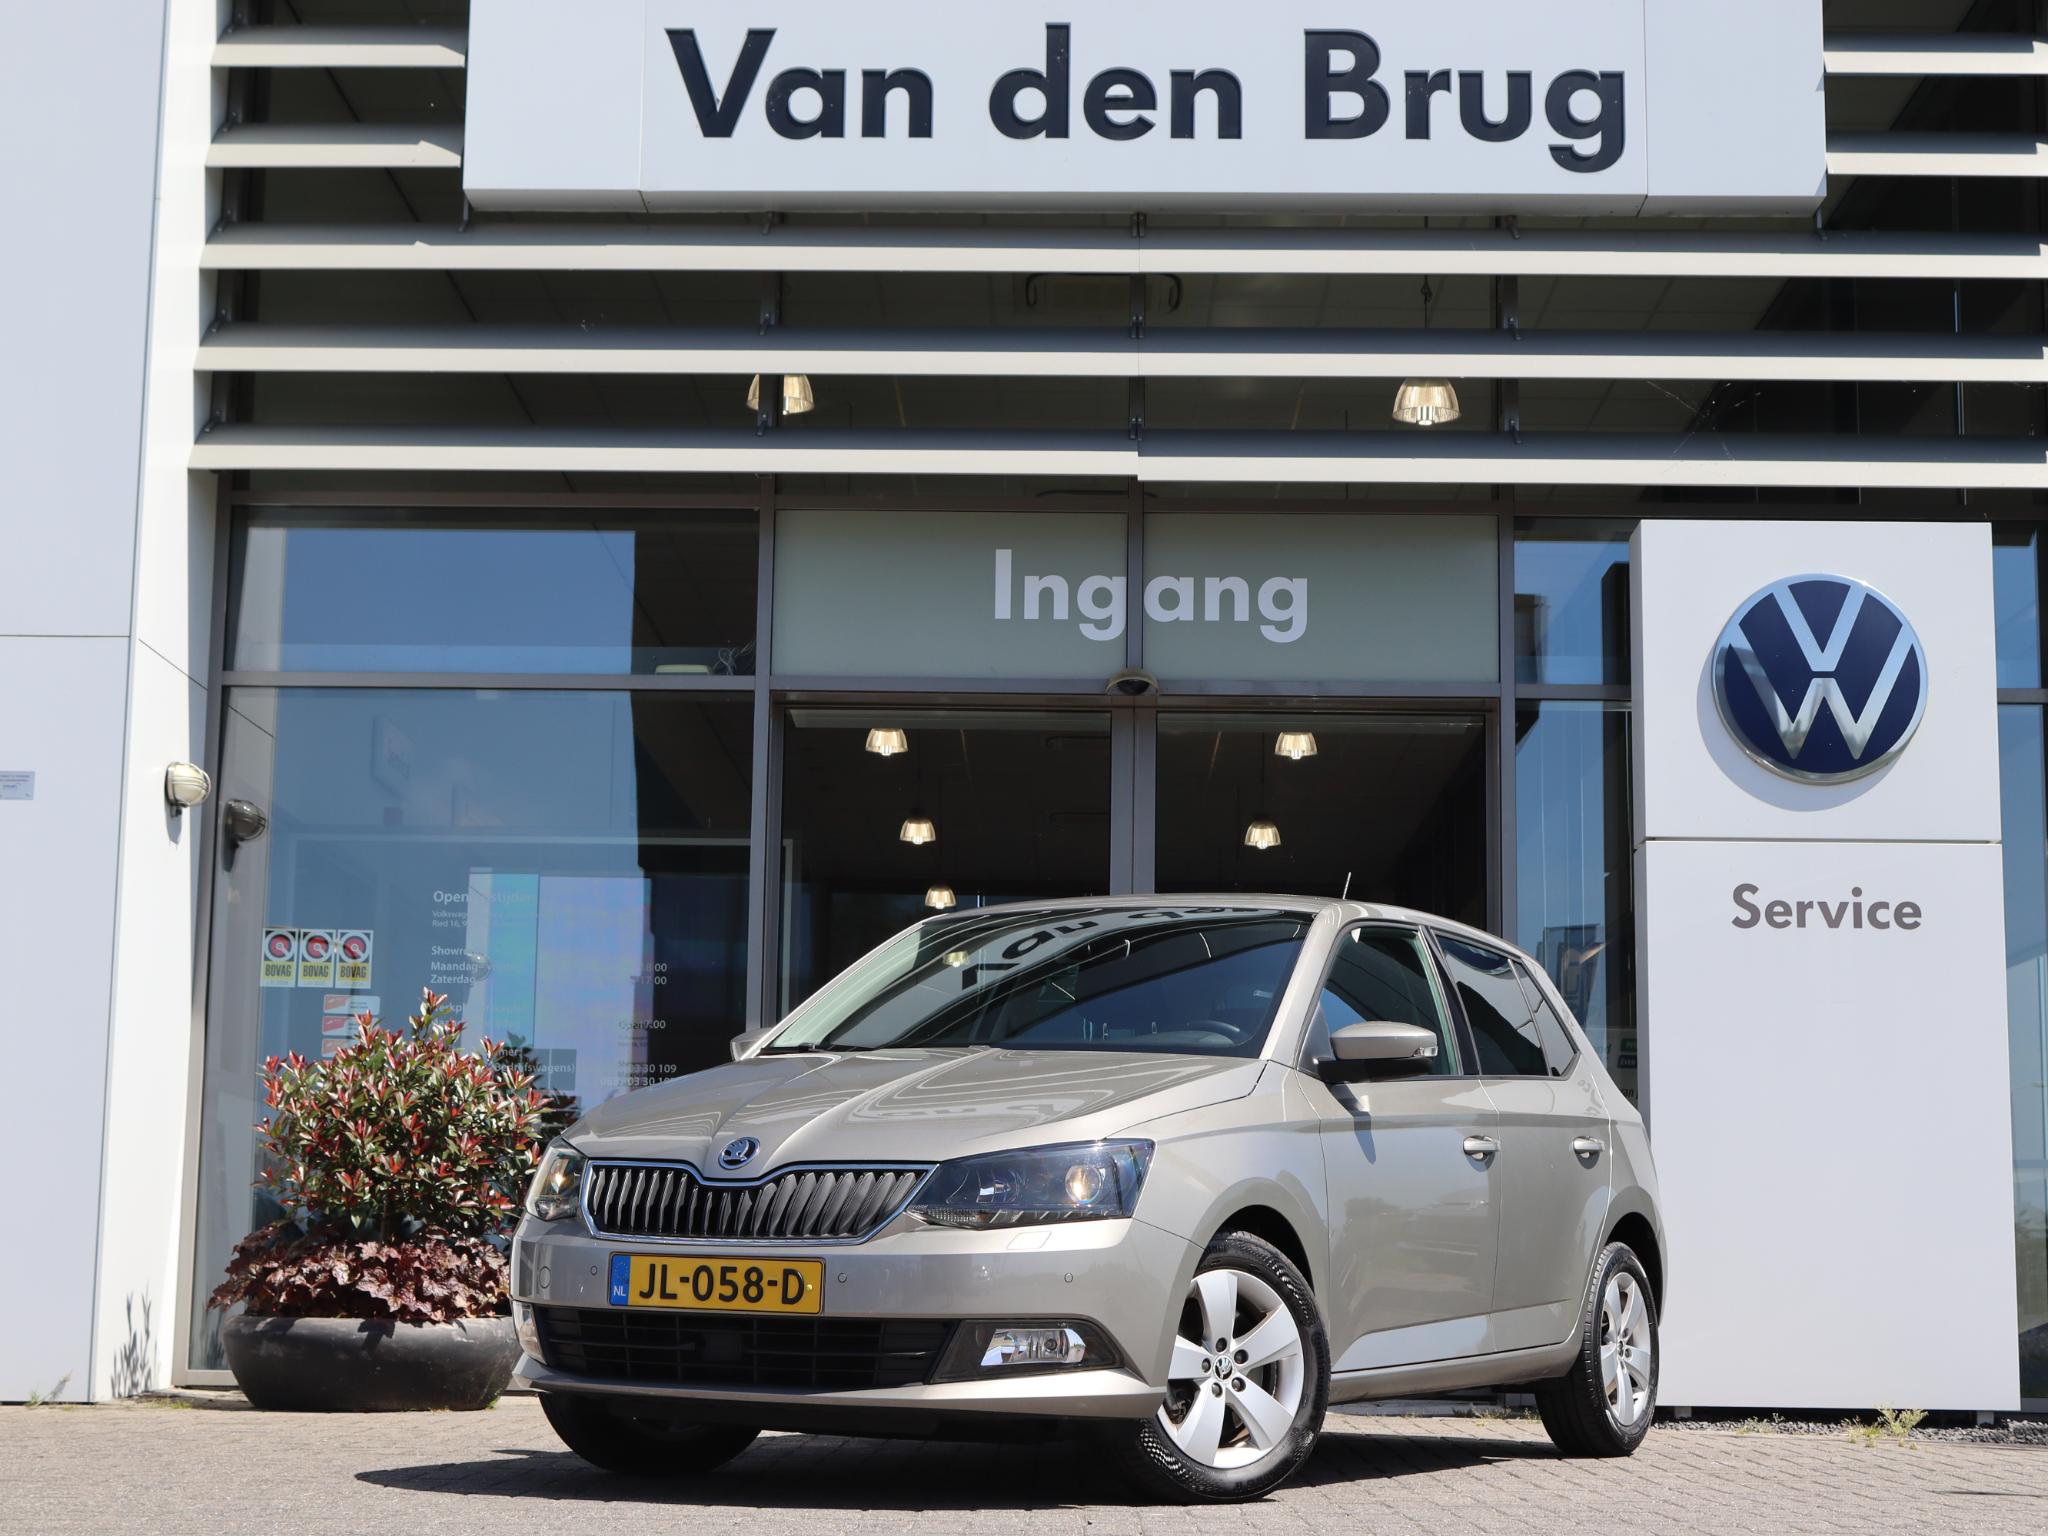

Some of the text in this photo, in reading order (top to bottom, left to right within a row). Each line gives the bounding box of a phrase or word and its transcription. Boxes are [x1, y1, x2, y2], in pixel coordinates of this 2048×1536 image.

[666, 22, 1627, 174] Van den Brug
[994, 548, 1308, 644] Ingang
[1731, 883, 1922, 930] Service
[431, 946, 466, 957] Showr
[265, 964, 291, 977] BOVAG
[303, 966, 329, 978] BOVAG
[340, 966, 367, 979] BOVAG
[658, 1064, 677, 1073] 109
[613, 1263, 805, 1305] NL JL-058-D
